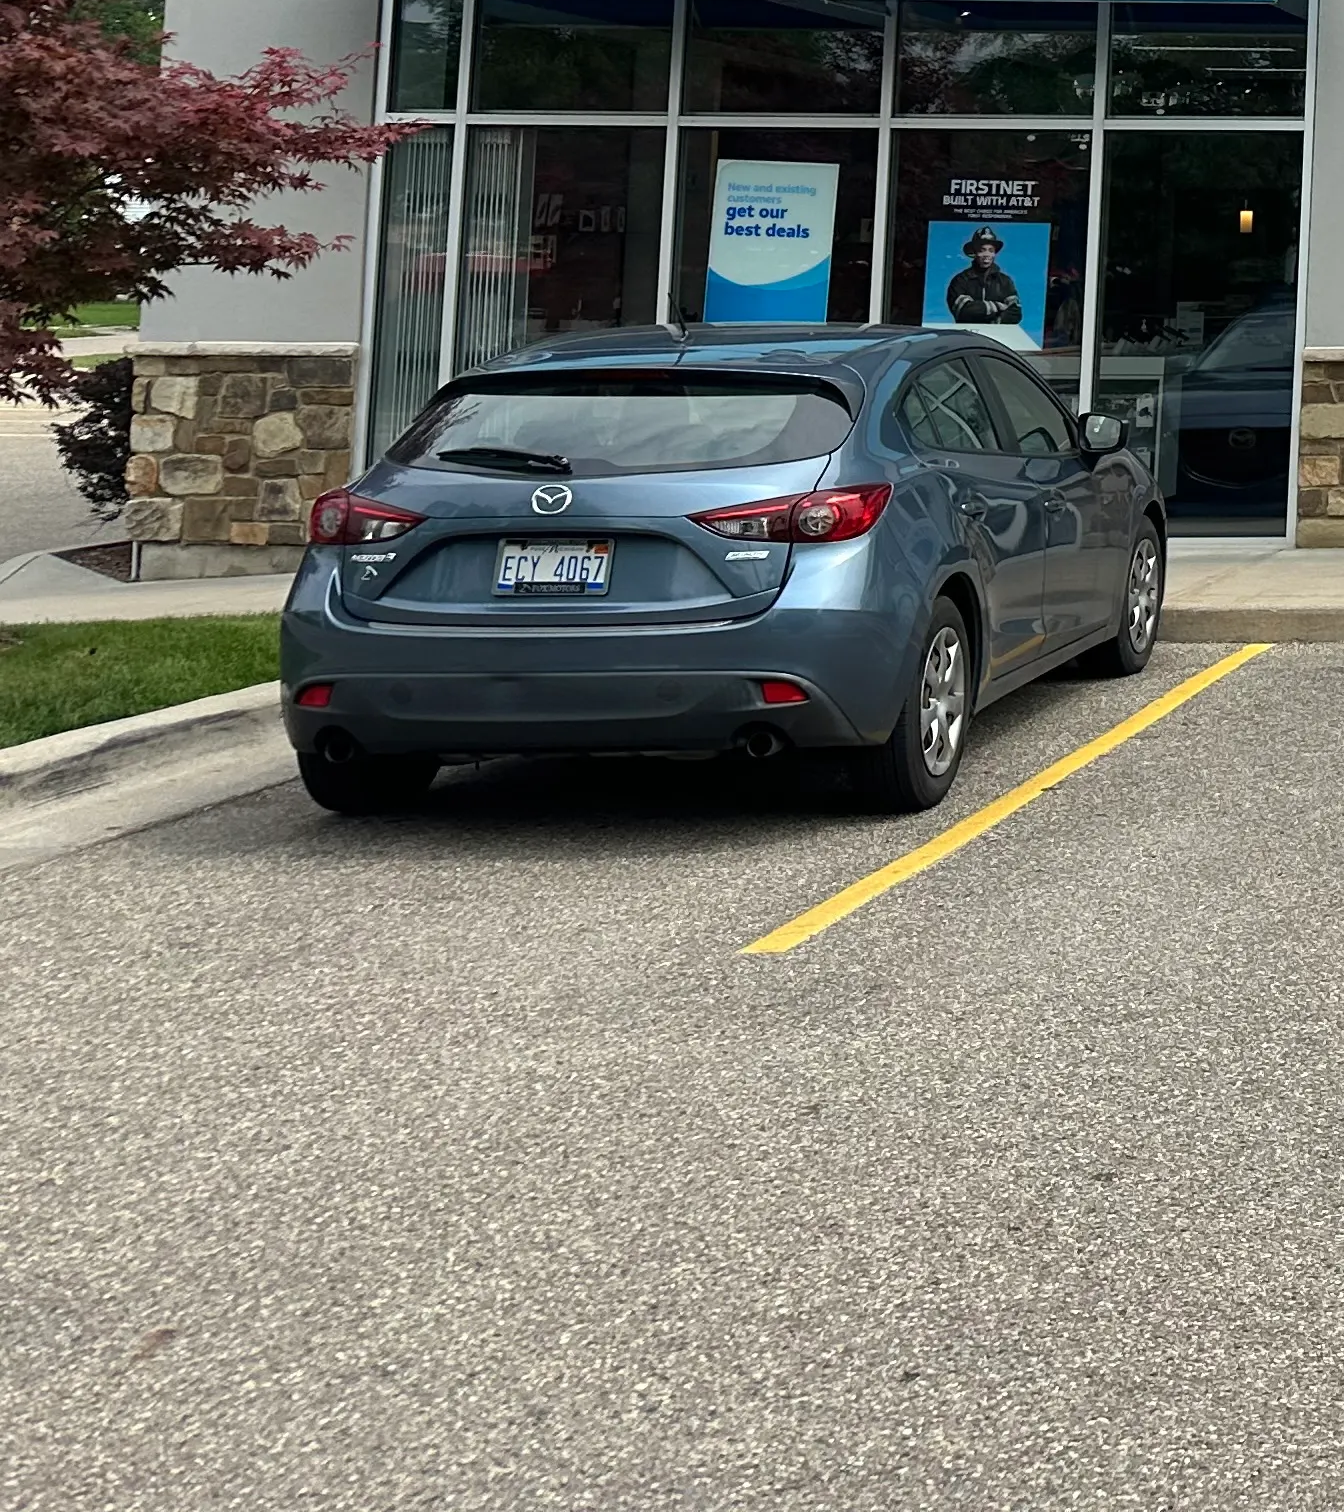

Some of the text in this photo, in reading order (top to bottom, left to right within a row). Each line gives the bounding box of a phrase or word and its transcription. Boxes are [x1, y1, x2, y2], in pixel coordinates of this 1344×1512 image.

[727, 182, 817, 196] New and existing
[950, 179, 1039, 195] FIRSTNET
[727, 195, 782, 204] customers
[942, 195, 1040, 207] BUILT WITH AT&T
[726, 205, 788, 221] get our
[724, 221, 810, 239] best deals
[502, 556, 604, 581] ECY 4067
